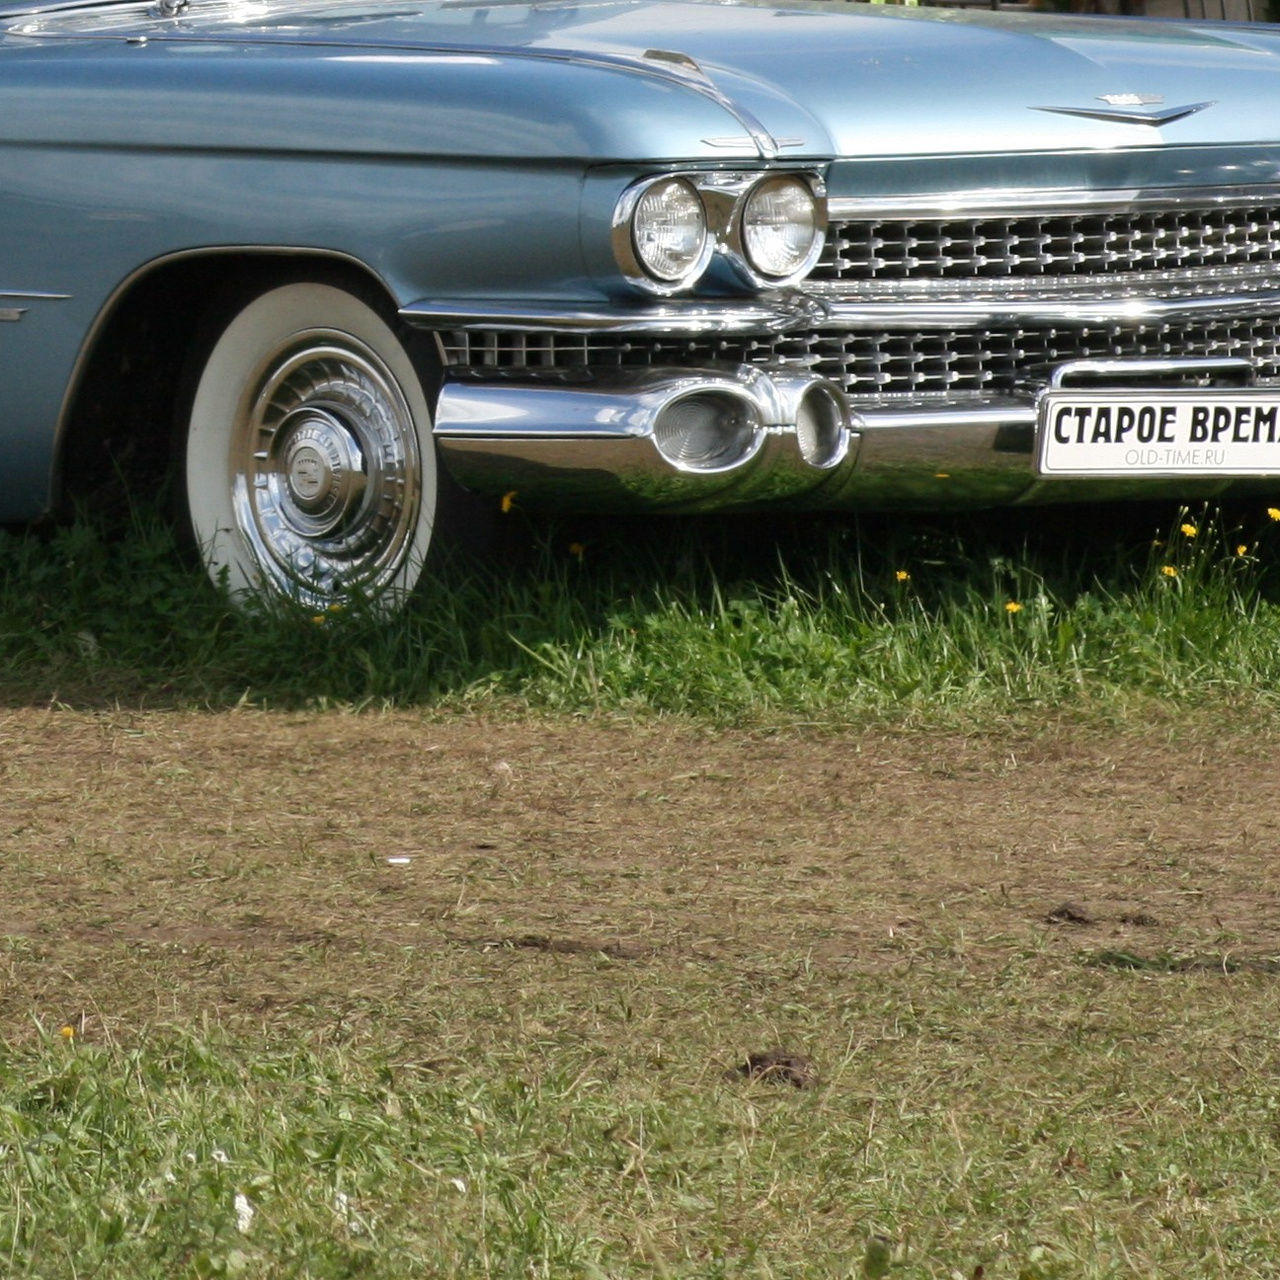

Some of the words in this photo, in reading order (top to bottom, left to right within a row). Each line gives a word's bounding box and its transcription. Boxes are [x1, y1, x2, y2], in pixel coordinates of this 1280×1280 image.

[1054, 405, 1178, 444] СТАРОЕ
[1189, 405, 1280, 444] ВРЕМ
[1124, 449, 1225, 466] OLD-TIME.RU
